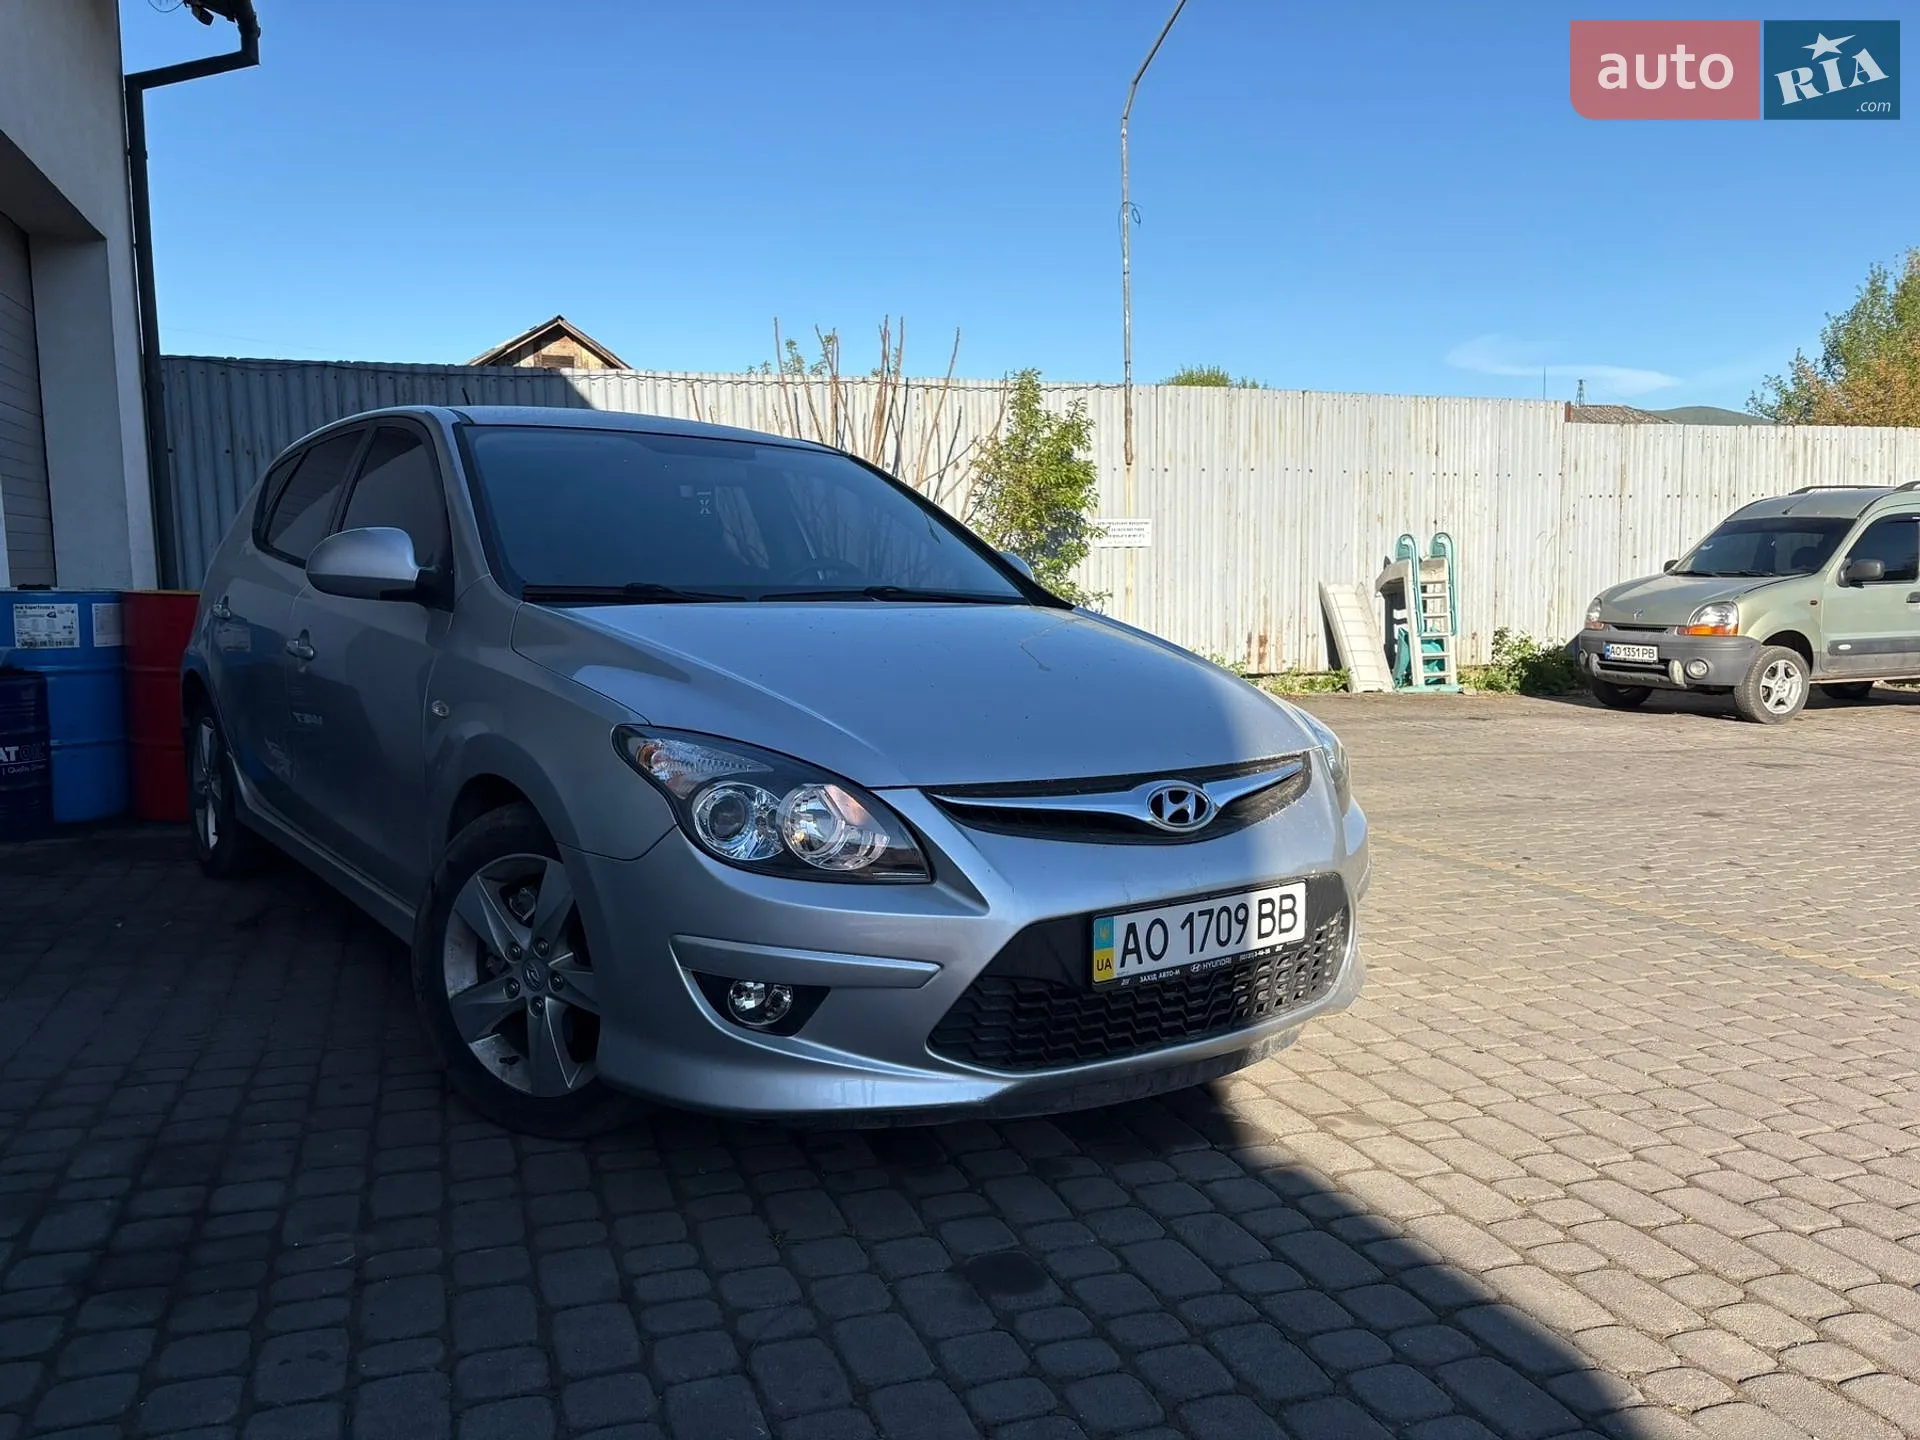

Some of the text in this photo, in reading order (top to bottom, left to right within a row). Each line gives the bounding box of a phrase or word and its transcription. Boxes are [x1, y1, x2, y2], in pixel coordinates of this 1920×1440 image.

[1611, 646, 1655, 659] AO 1351 PB
[1119, 893, 1298, 968] AO 1709 BB
[1096, 957, 1113, 971] UA
[1202, 956, 1233, 970] HYUNDAI
